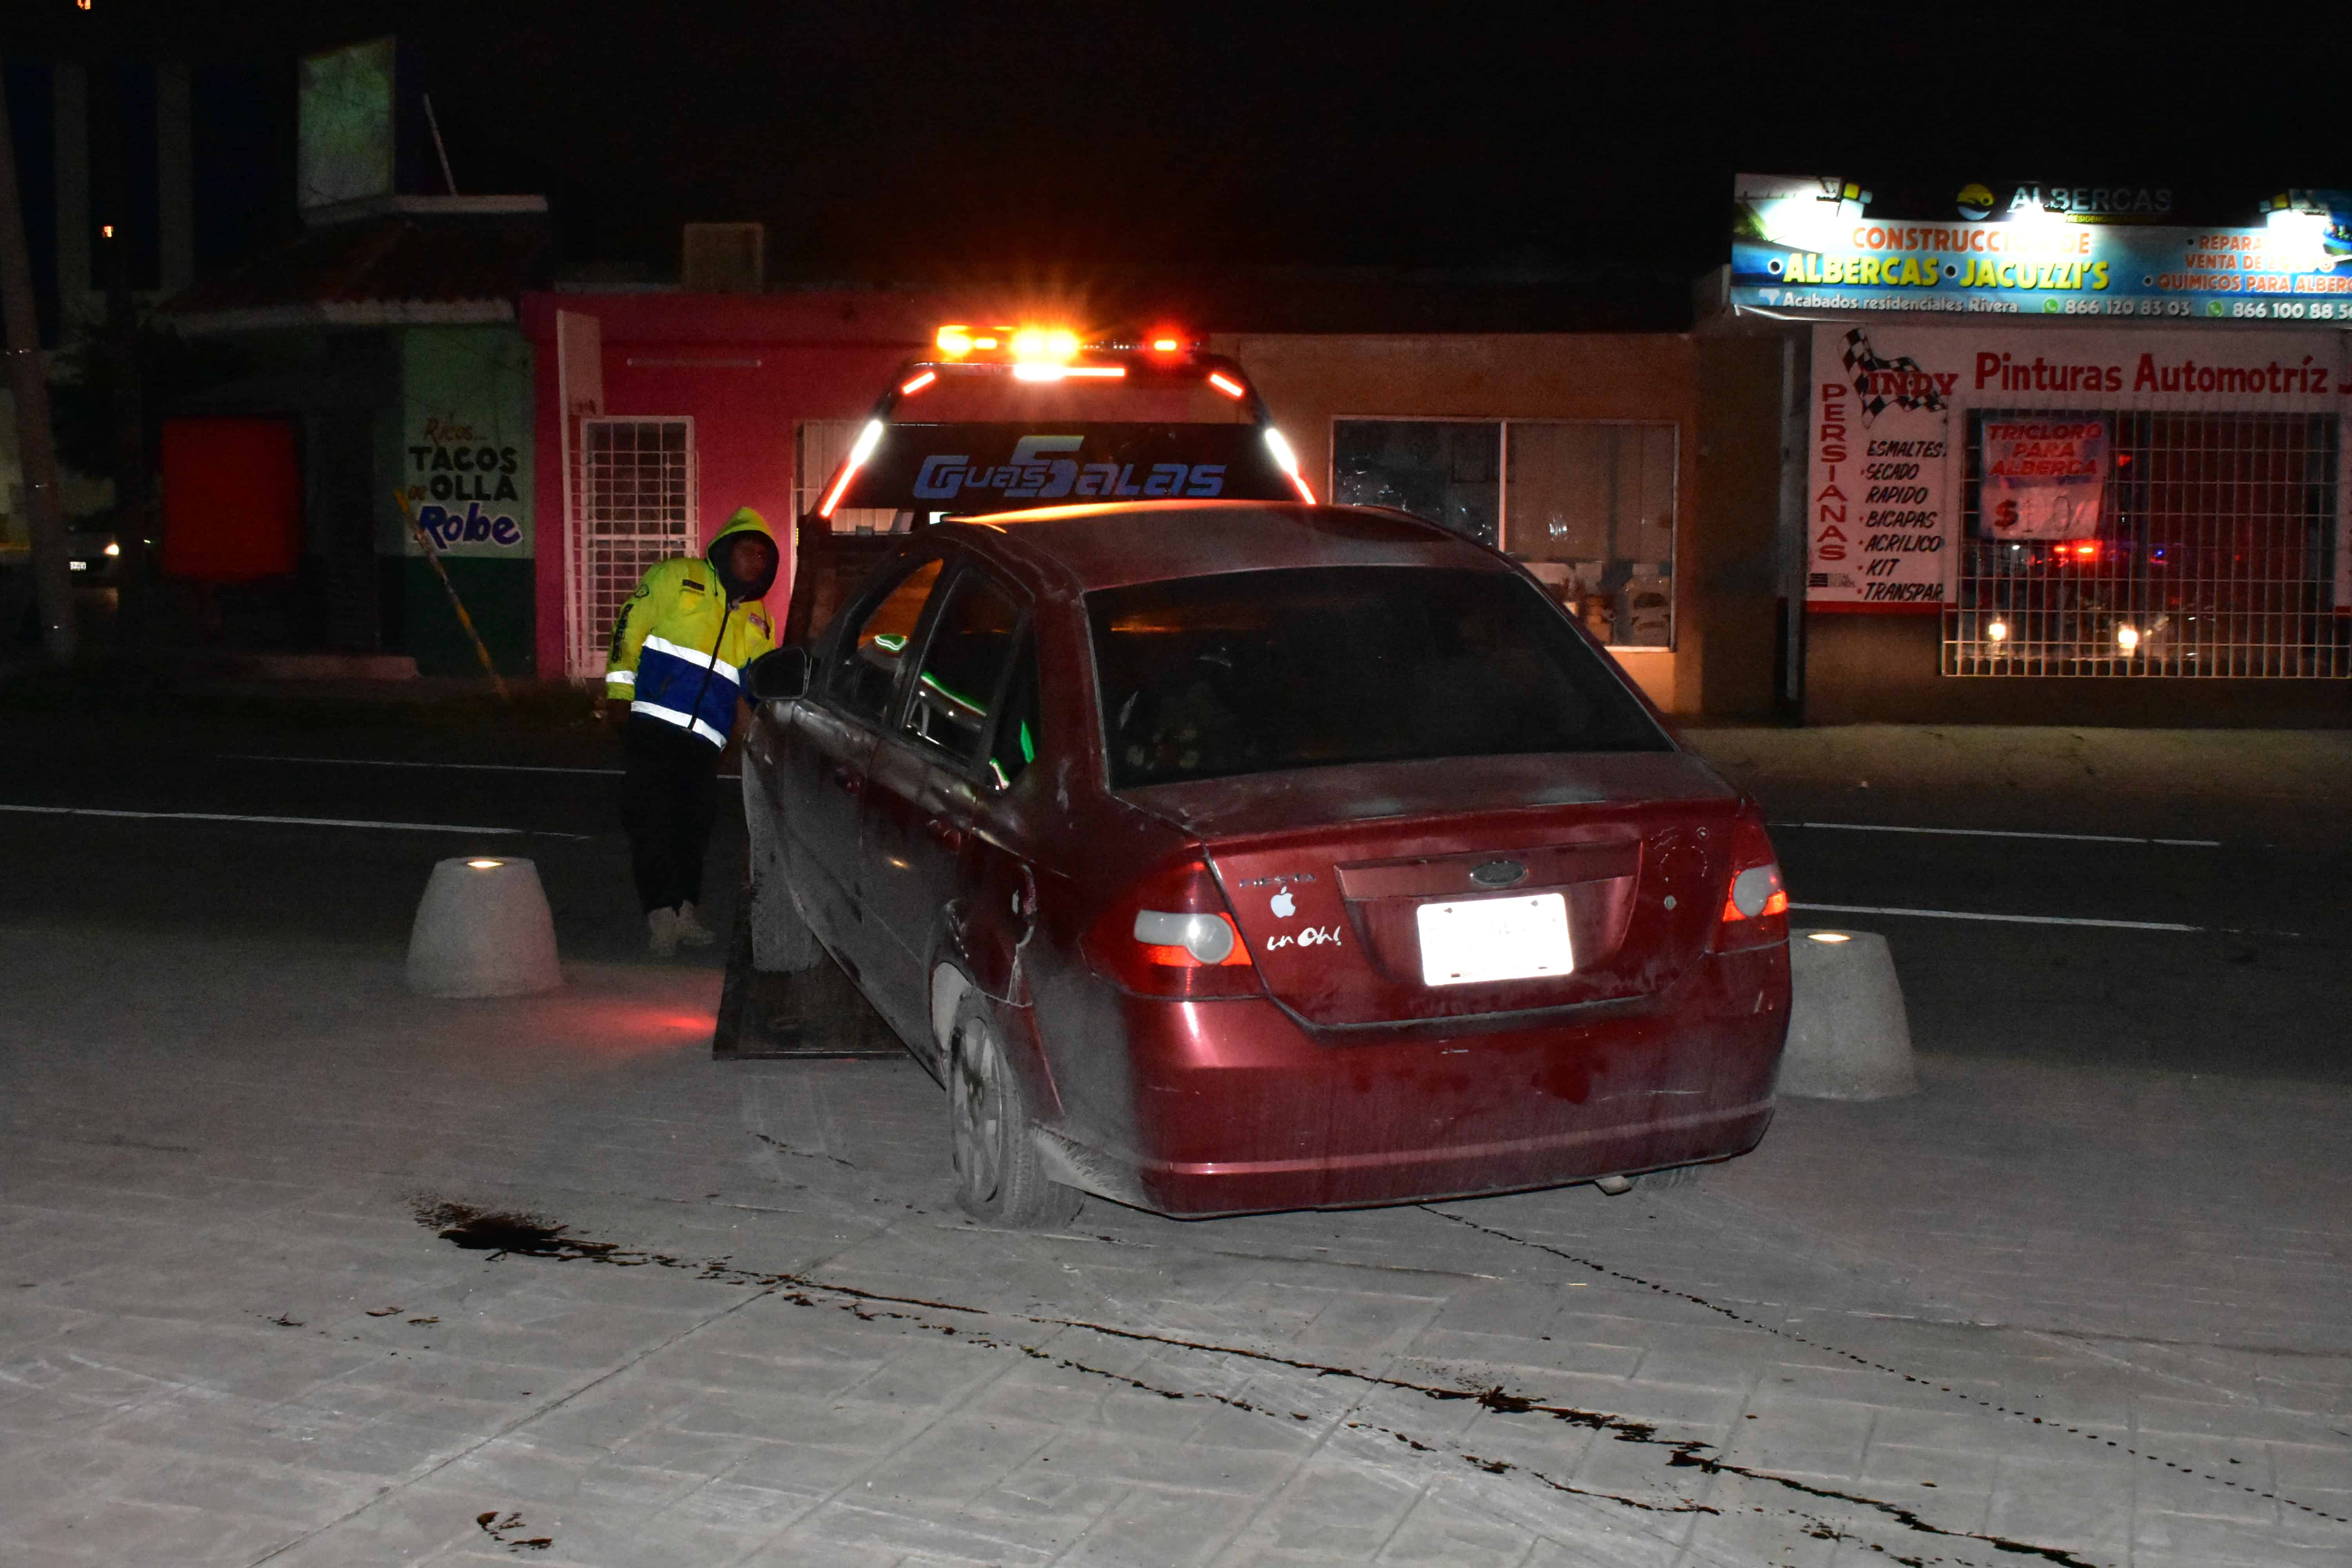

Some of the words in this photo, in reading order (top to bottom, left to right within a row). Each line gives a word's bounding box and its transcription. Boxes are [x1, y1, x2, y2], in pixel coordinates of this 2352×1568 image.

[2185, 254, 2236, 270] VENTA
[2242, 255, 2261, 270] DE
[1783, 252, 1939, 286] ALBERCAS
[1959, 259, 2109, 291] JACUZZI'S
[2246, 275, 2291, 292] PARA
[1782, 292, 1858, 309] Acabados
[1863, 295, 1963, 312] residenciales
[1967, 296, 2019, 314] Rivera
[2064, 298, 2101, 314] 866
[2106, 299, 2135, 315] 120
[2167, 300, 2191, 317] 03
[2232, 303, 2267, 318] 866
[2272, 303, 2305, 319] 100
[2309, 303, 2334, 319] 88
[1975, 352, 2122, 392] Pinturas
[2133, 353, 2328, 394] Automotríz
[1867, 371, 1959, 396] INDY
[1989, 423, 2102, 439] TRICLORO
[2013, 442, 2074, 457] PARA
[408, 446, 518, 474] TACOS
[1988, 459, 2097, 475] ALBERCA
[1817, 383, 1848, 561] PERSIANAS
[1866, 463, 1920, 480] SECADO
[431, 474, 519, 501] OLLA
[1865, 486, 1929, 505] RAPIDO
[419, 501, 522, 550] Robe
[1865, 511, 1937, 528] BICAPAS
[1864, 534, 1943, 552] ACRILICO
[1866, 558, 1900, 576] KIT
